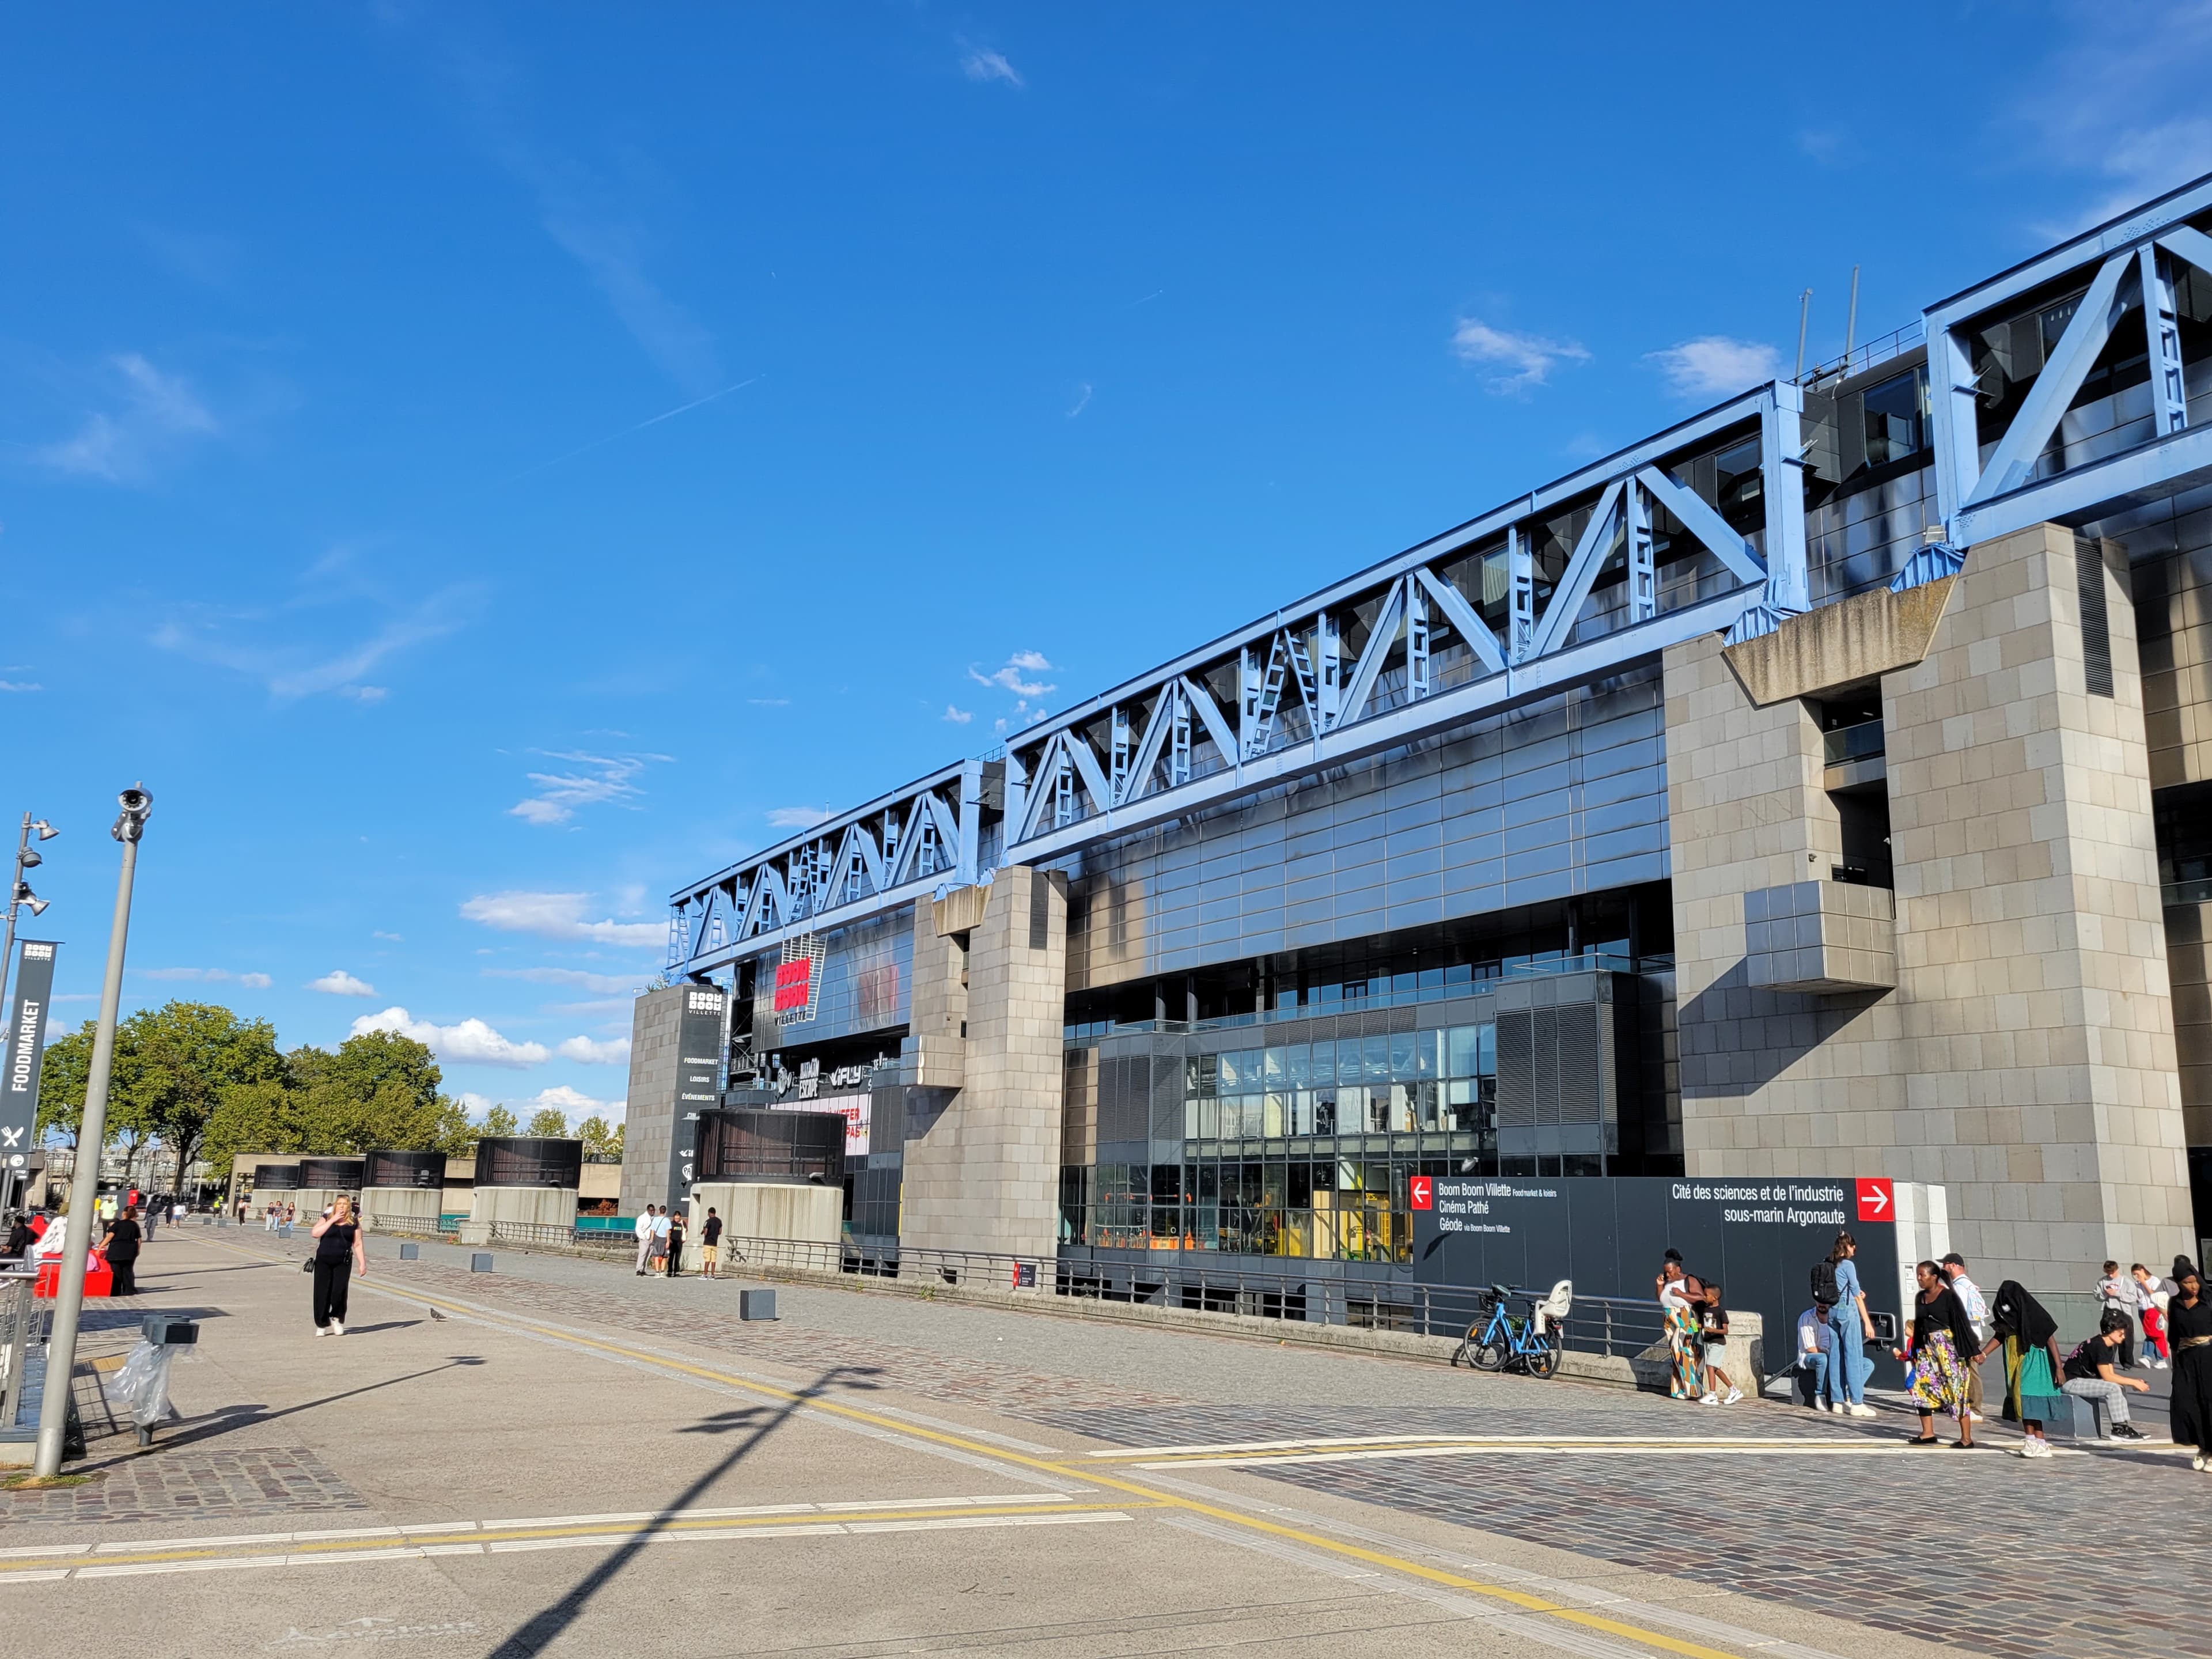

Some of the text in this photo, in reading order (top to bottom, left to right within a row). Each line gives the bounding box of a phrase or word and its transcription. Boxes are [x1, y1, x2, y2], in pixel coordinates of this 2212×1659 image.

[690, 991, 722, 1002] BOOM
[689, 1000, 722, 1011] BOOM
[774, 1010, 806, 1026] VILLETTE
[12, 999, 40, 1092] FOODMARKET
[684, 1057, 718, 1065] FOODMARKET
[799, 1078, 818, 1099] ESCAPE
[681, 1093, 715, 1101] ÉVÉNEMENTS
[1439, 1183, 1460, 1196] Boom
[1462, 1183, 1484, 1196] Boom
[1486, 1183, 1512, 1197] Villette
[1539, 1189, 1543, 1198] &
[1543, 1189, 1557, 1198] loisirs
[1672, 1183, 1843, 1202] Cité des sciences et de l'industrie
[1440, 1199, 1489, 1214] Cinéma Pathé
[1725, 1207, 1845, 1227] sous-marin Argonaute
[1440, 1217, 1463, 1232] Géode
[1470, 1224, 1483, 1232] Boom
[1483, 1224, 1496, 1233] Boom
[1496, 1225, 1510, 1233] Villette
